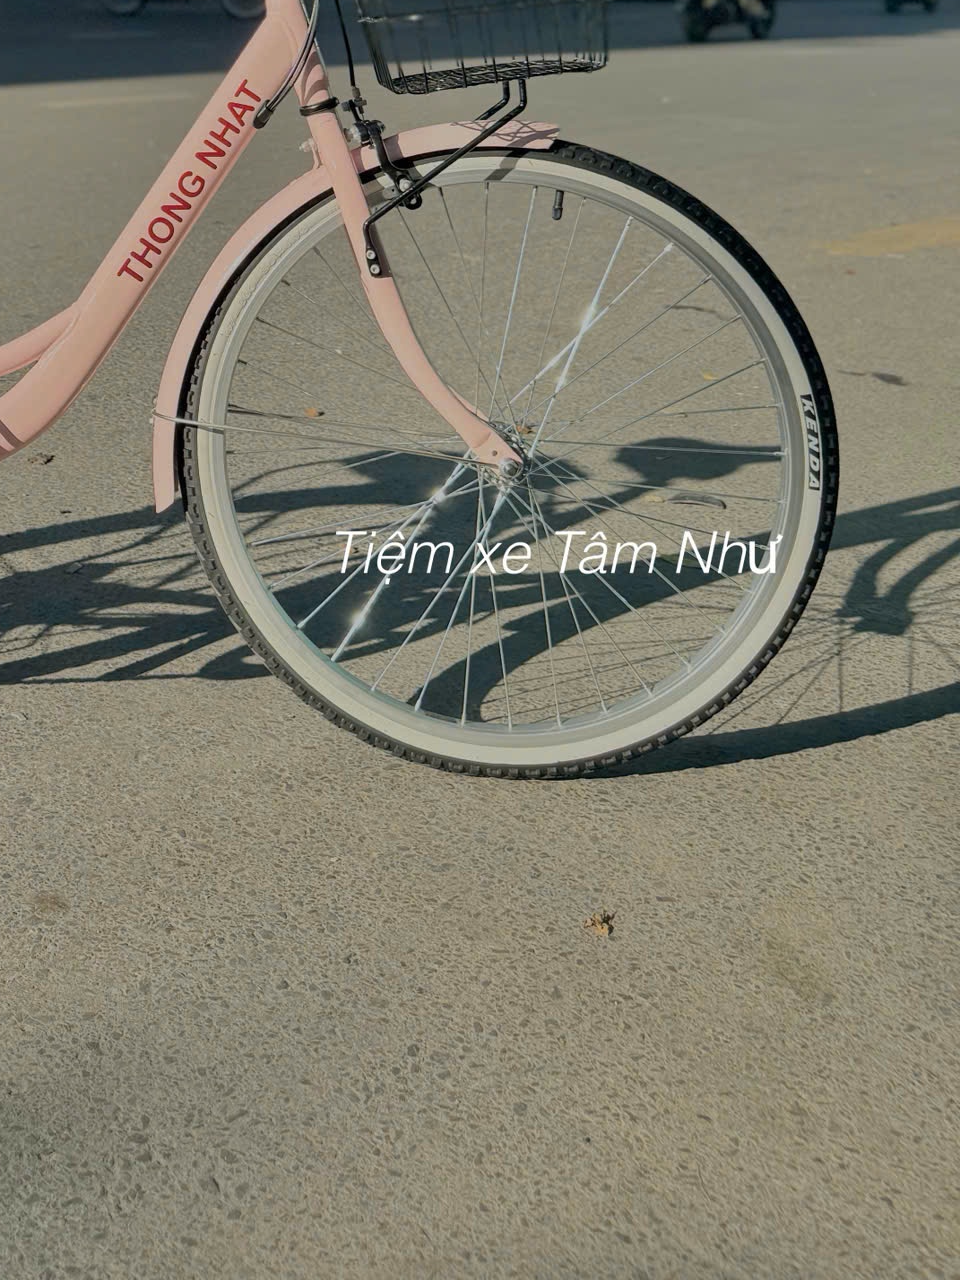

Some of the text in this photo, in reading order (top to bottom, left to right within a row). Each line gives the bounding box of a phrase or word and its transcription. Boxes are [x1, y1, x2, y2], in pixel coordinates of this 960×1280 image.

[117, 78, 262, 282] THONG NHAT
[800, 393, 820, 491] KENDA
